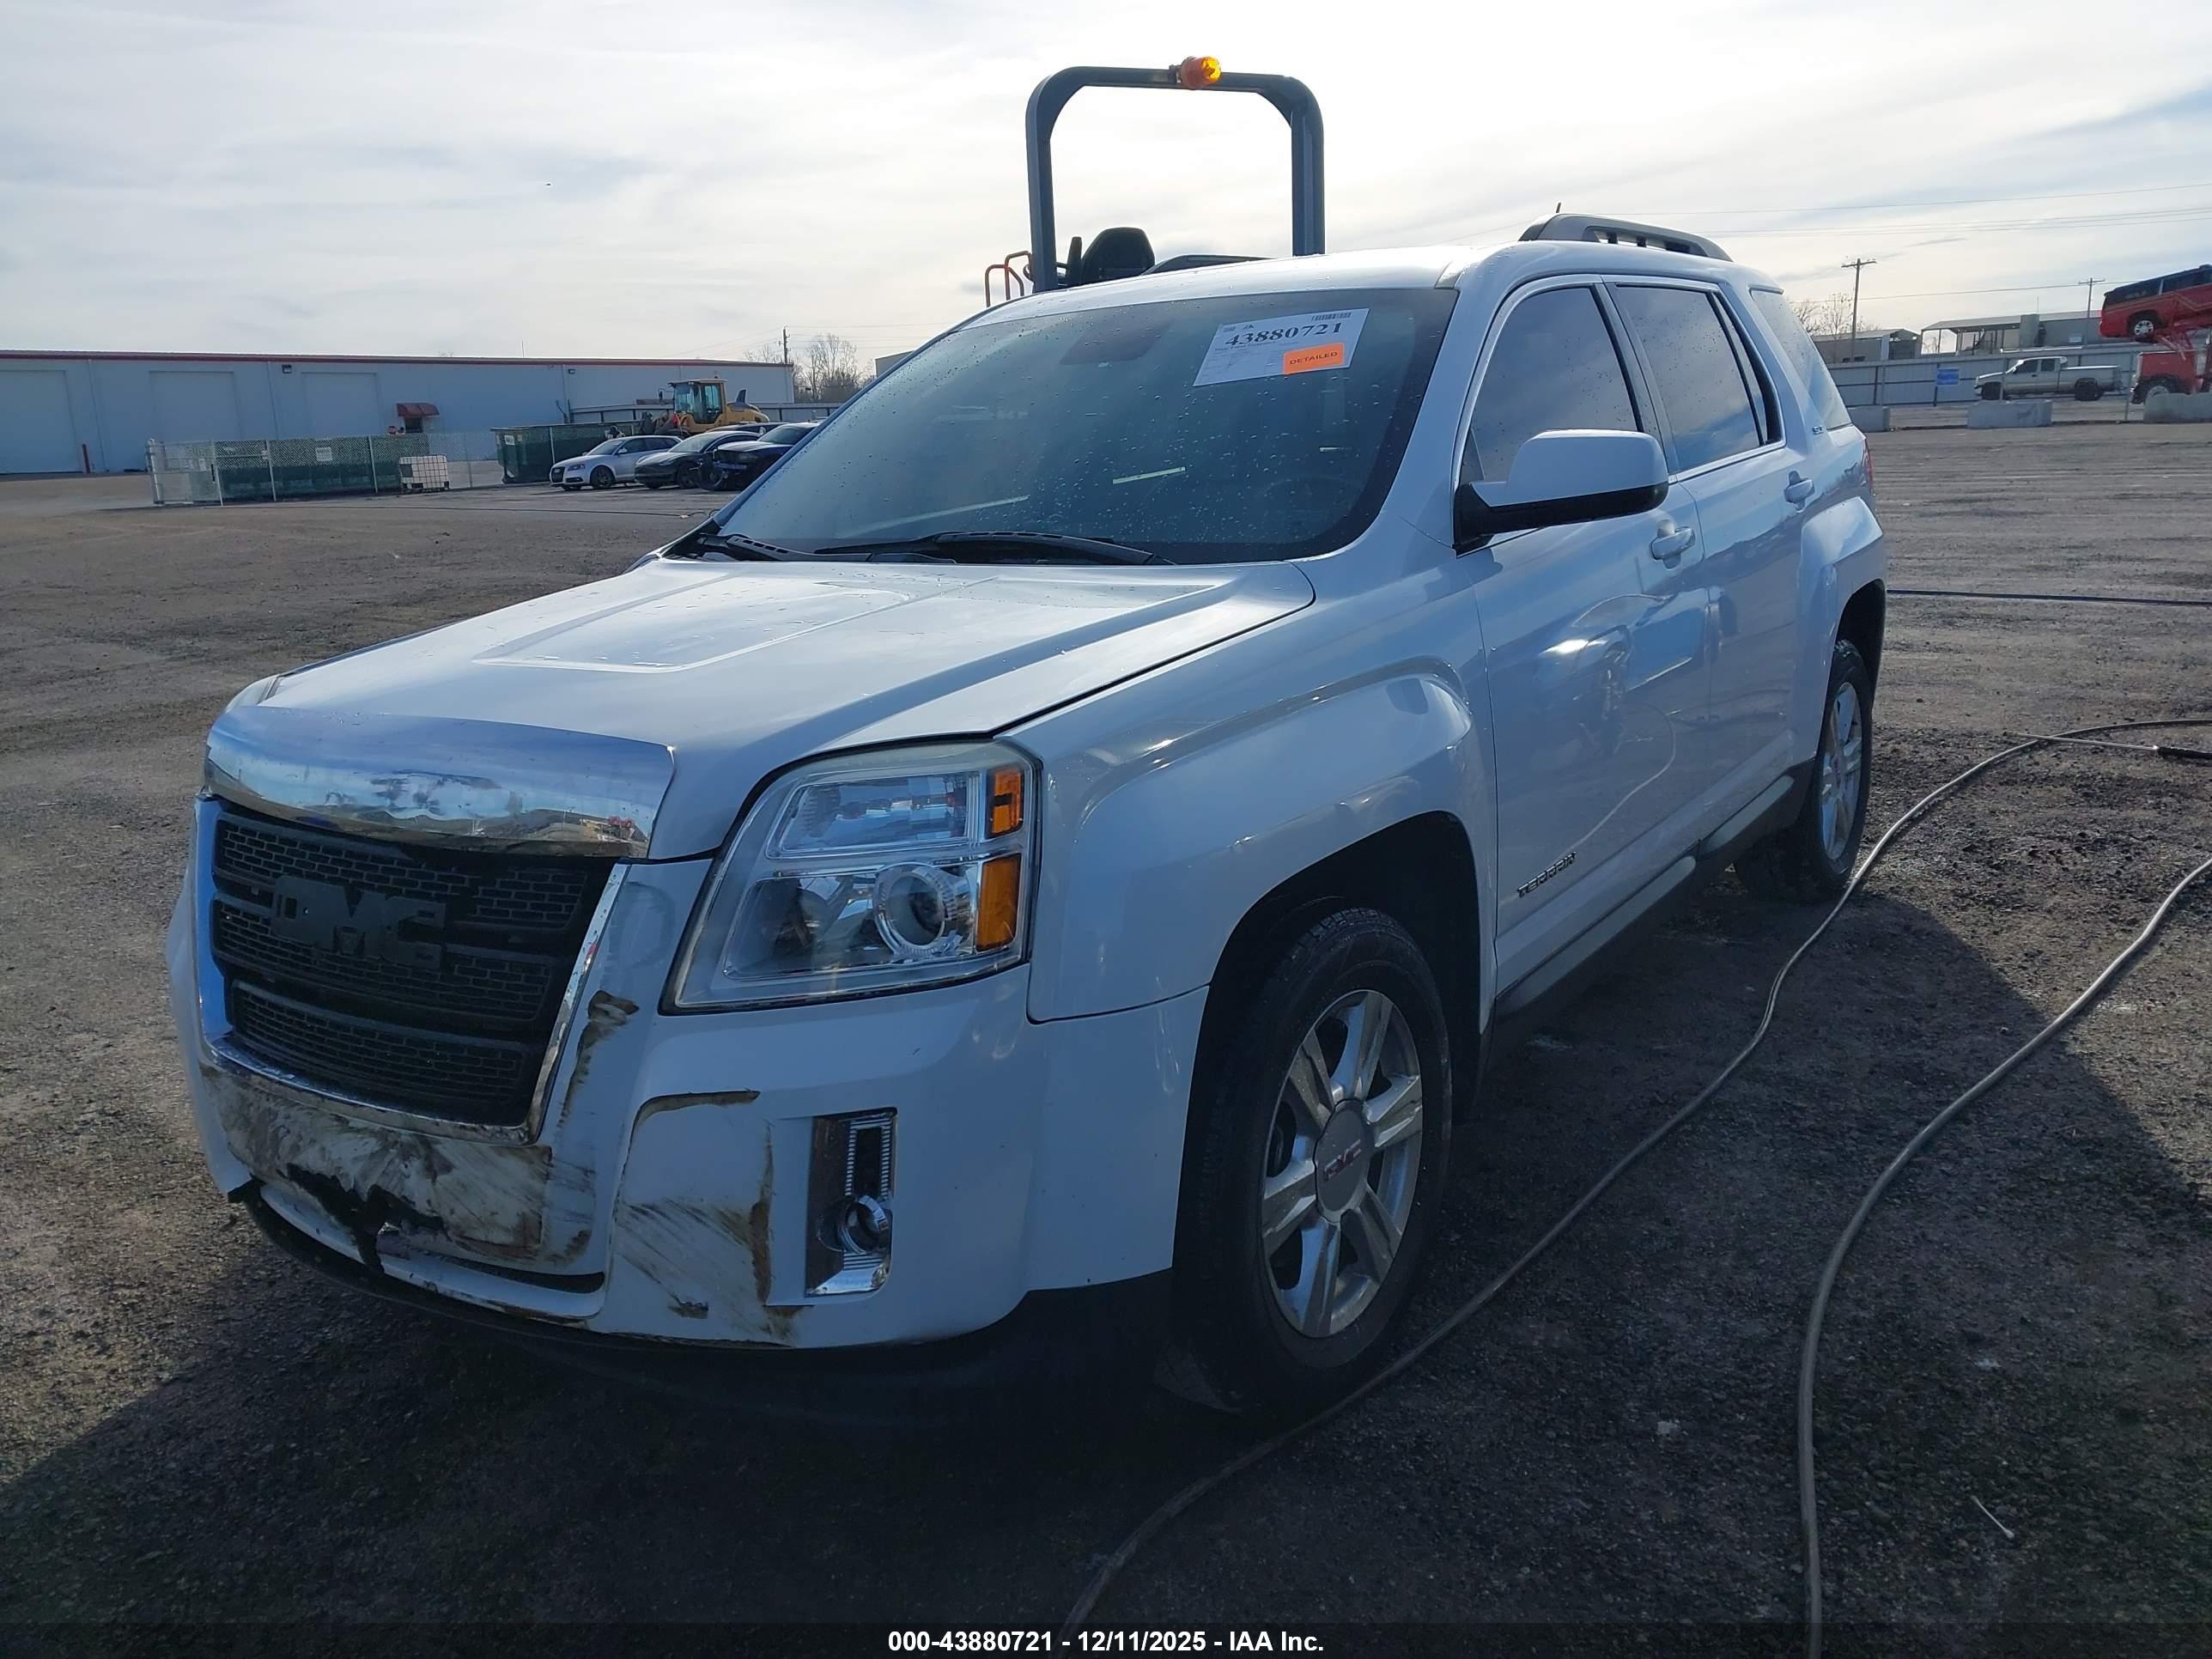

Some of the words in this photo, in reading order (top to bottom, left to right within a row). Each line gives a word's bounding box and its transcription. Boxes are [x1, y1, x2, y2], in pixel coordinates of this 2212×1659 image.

[1225, 322, 1342, 346] 43880721
[1289, 351, 1339, 365] DETAILED
[1517, 851, 1577, 898] TERRAIN
